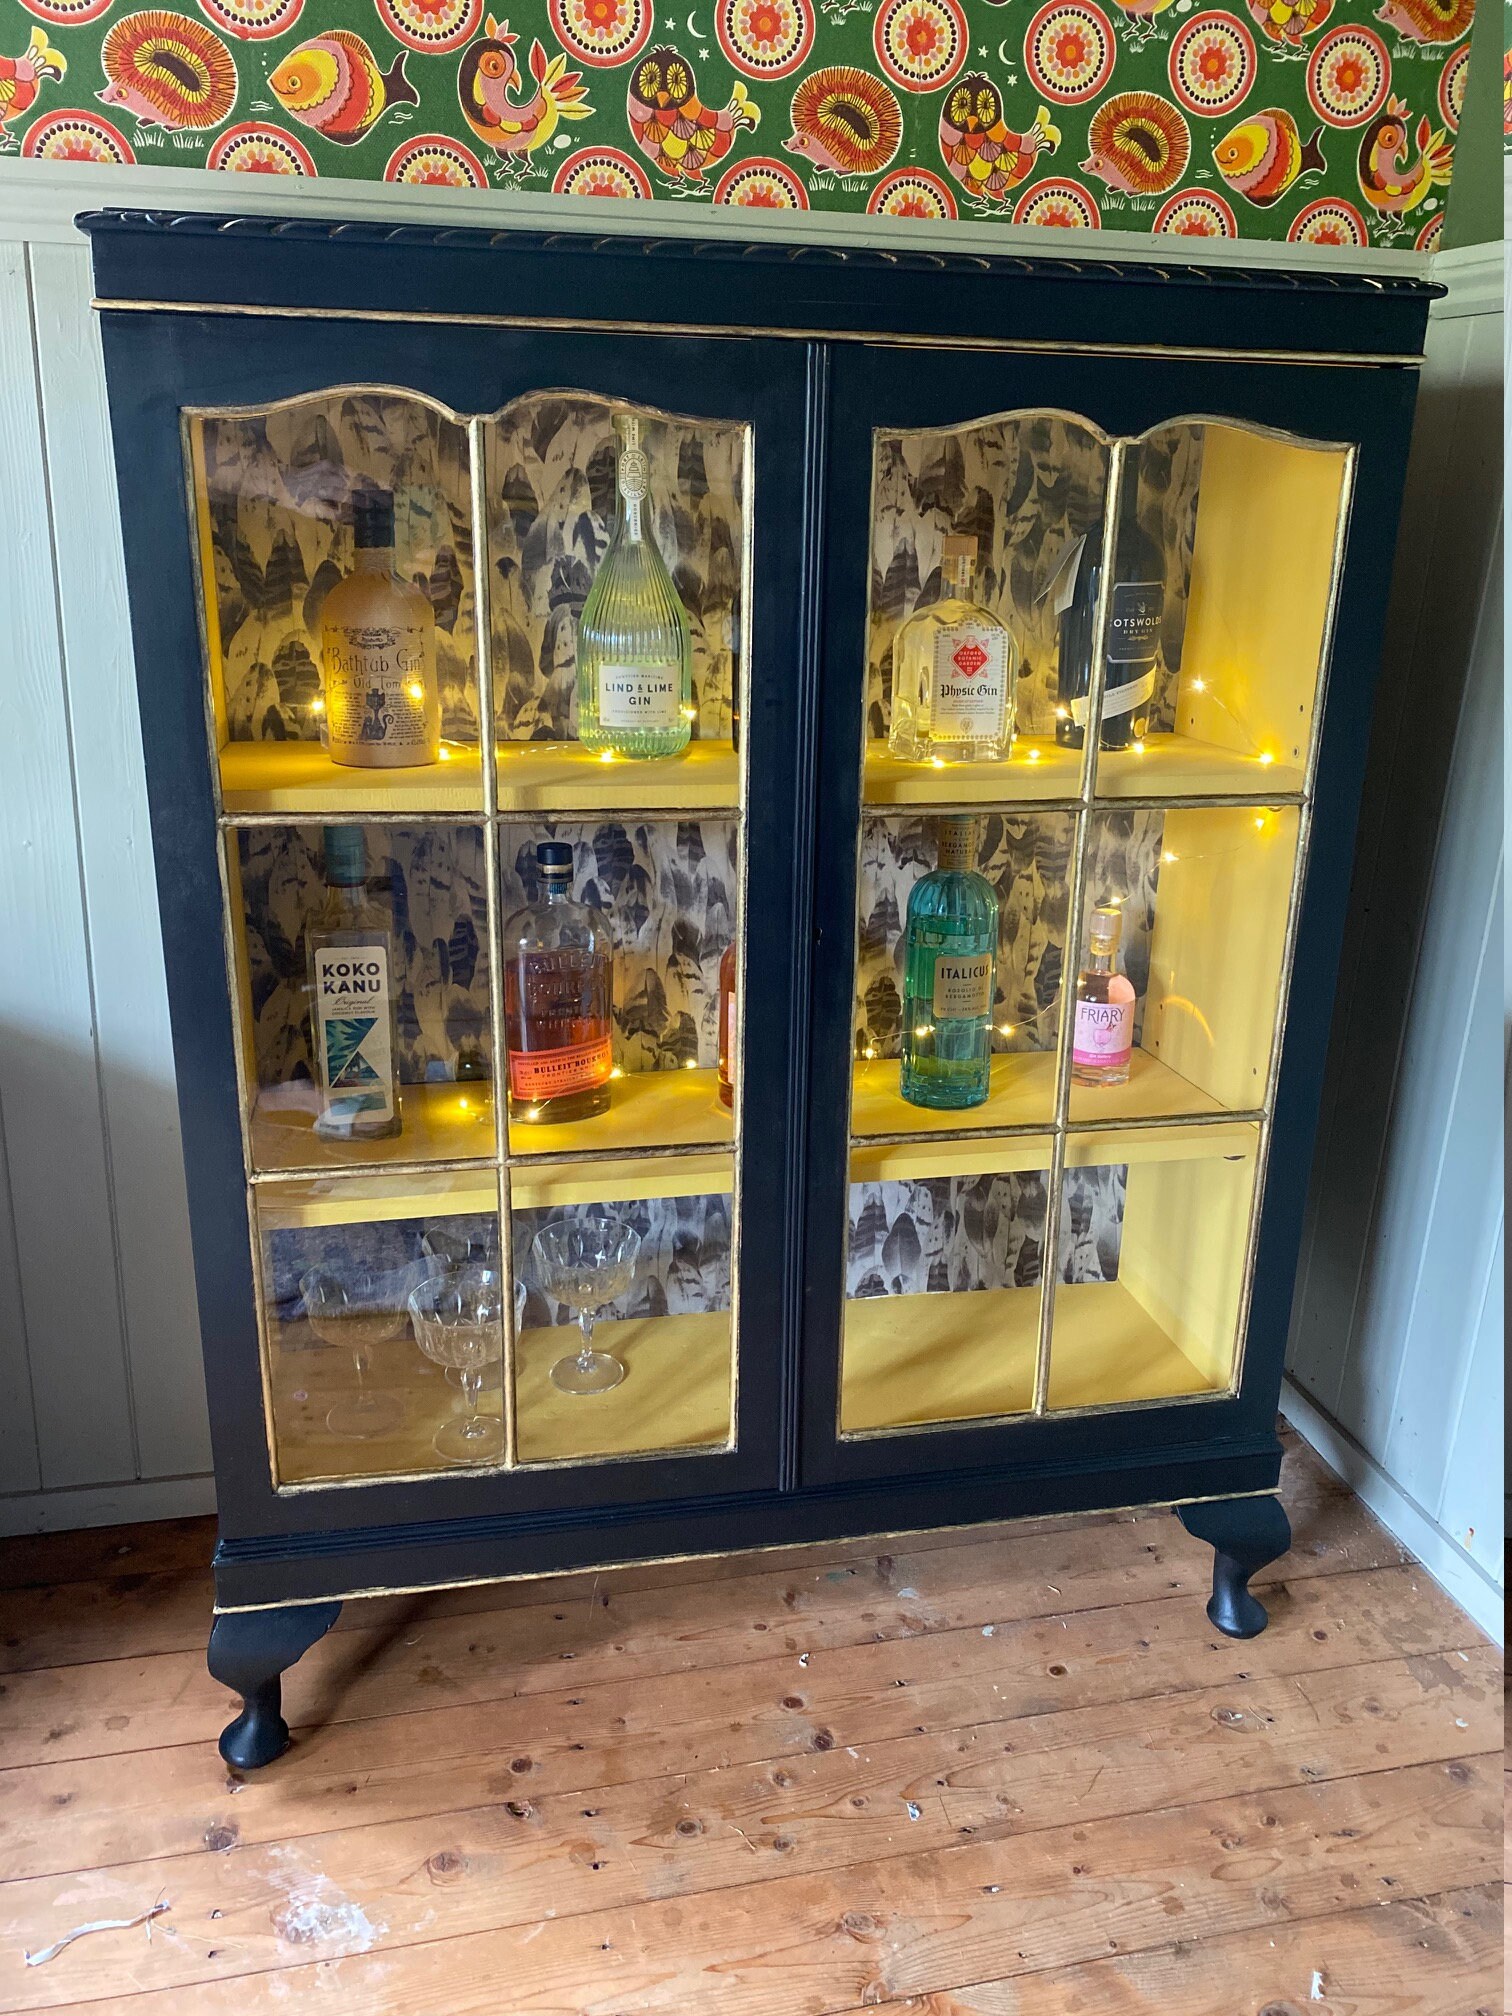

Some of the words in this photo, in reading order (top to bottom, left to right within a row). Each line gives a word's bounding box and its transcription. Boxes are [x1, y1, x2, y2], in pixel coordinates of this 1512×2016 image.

[1110, 616, 1162, 628] OTSWOLDS
[329, 647, 390, 675] Bathtub
[396, 649, 420, 672] Gin
[353, 674, 371, 689] Old
[376, 676, 402, 690] Tom
[605, 682, 634, 693] LIND
[637, 683, 644, 693] &
[647, 683, 673, 693] LIME
[940, 684, 975, 698] Physic
[976, 684, 998, 696] Gin
[628, 696, 651, 706] GIN
[322, 962, 380, 978] KOKO
[941, 964, 989, 979] ITALICUS
[323, 979, 381, 995] KANU
[332, 995, 375, 1007] Original
[1080, 1007, 1126, 1024] FRIARY
[534, 1062, 571, 1074] BULLEIT
